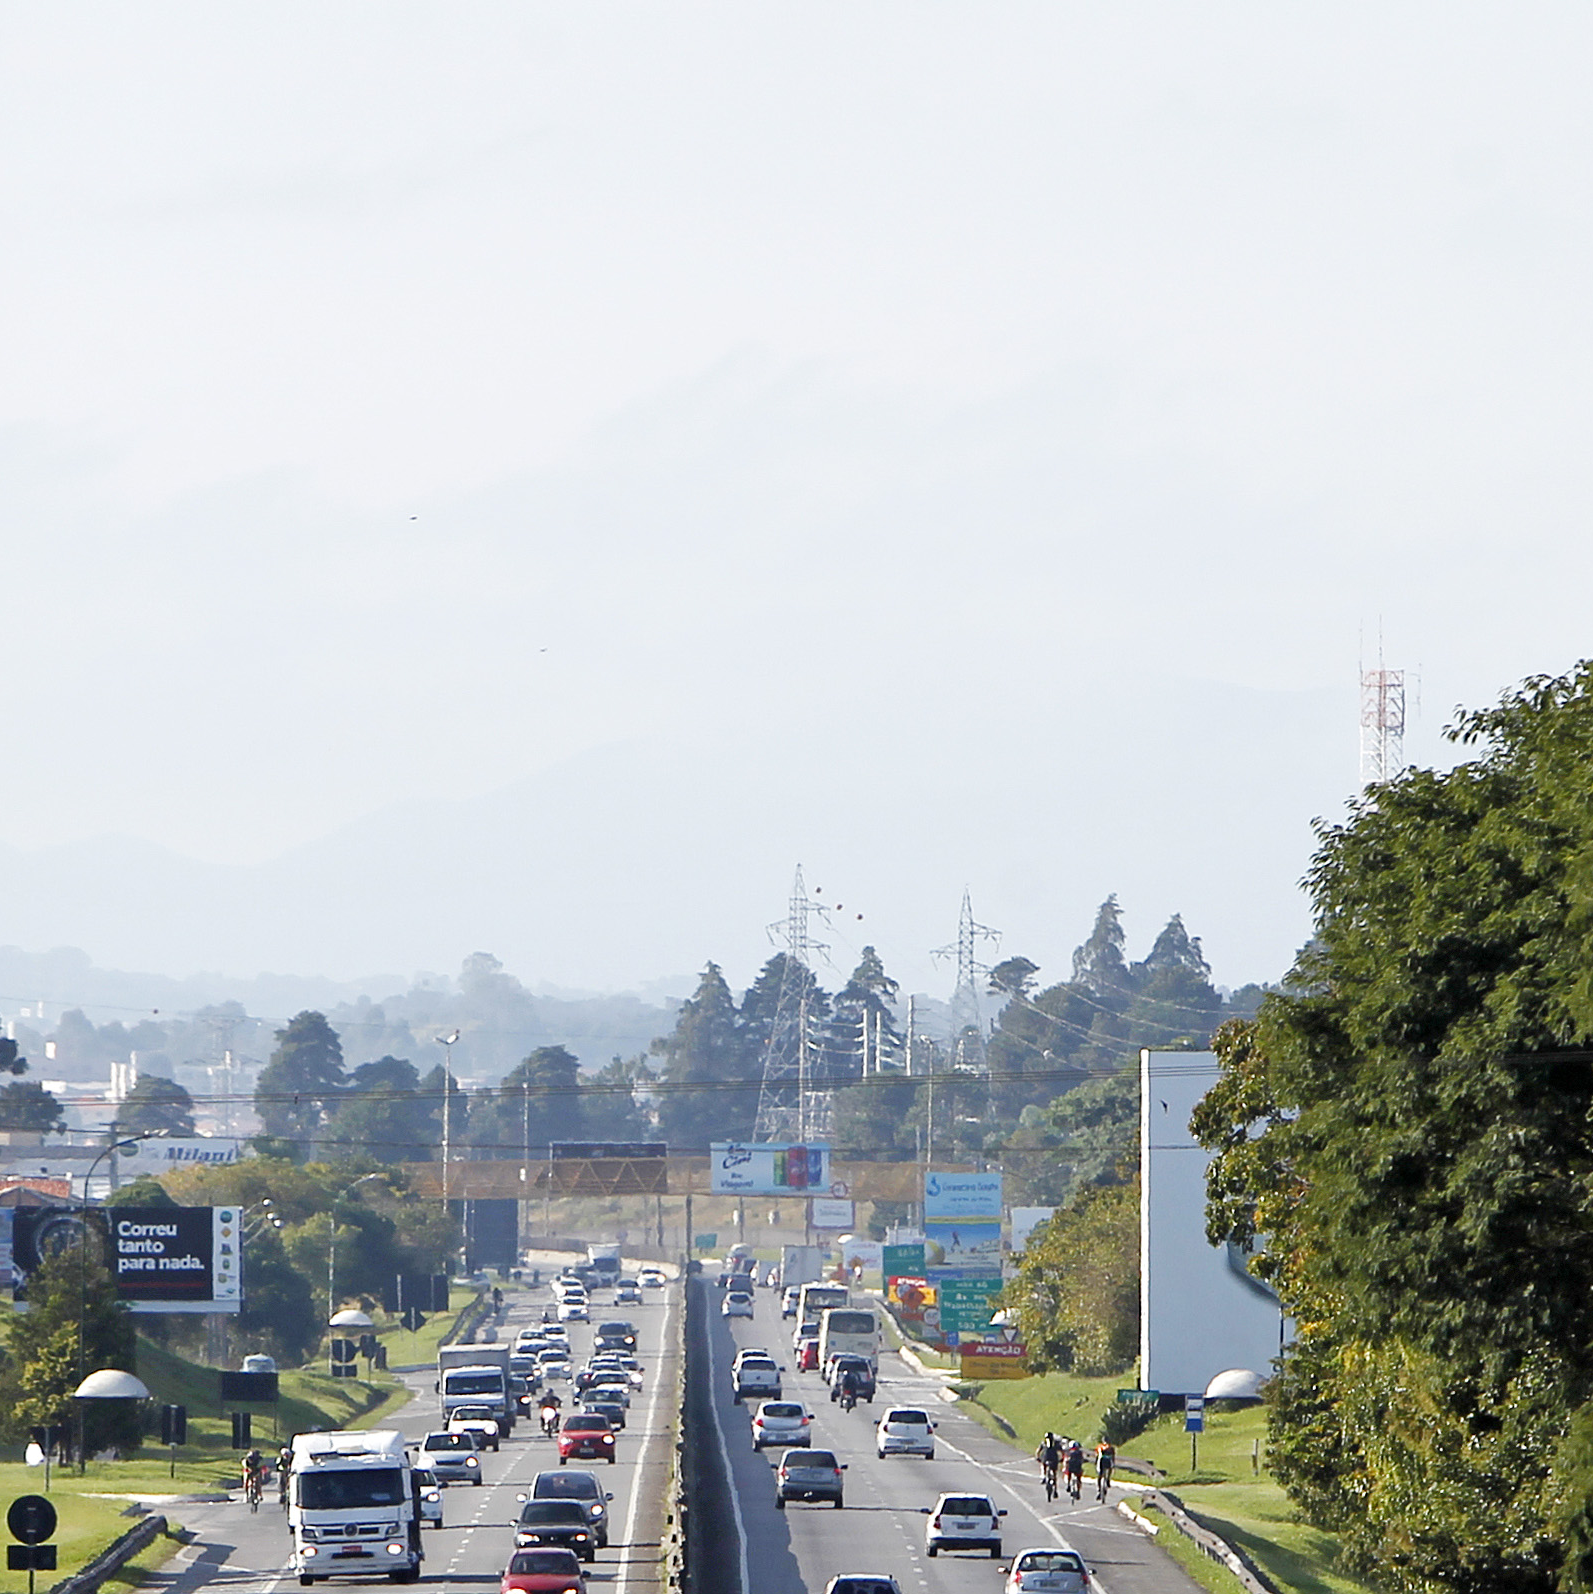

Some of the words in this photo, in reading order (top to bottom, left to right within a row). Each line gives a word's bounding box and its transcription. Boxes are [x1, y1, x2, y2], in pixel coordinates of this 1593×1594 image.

[117, 1220, 177, 1236] Correu
[117, 1239, 165, 1253] tanto
[117, 1257, 155, 1273] para
[158, 1254, 205, 1270] nada.
[975, 1345, 1021, 1355] ATENÇÃO
